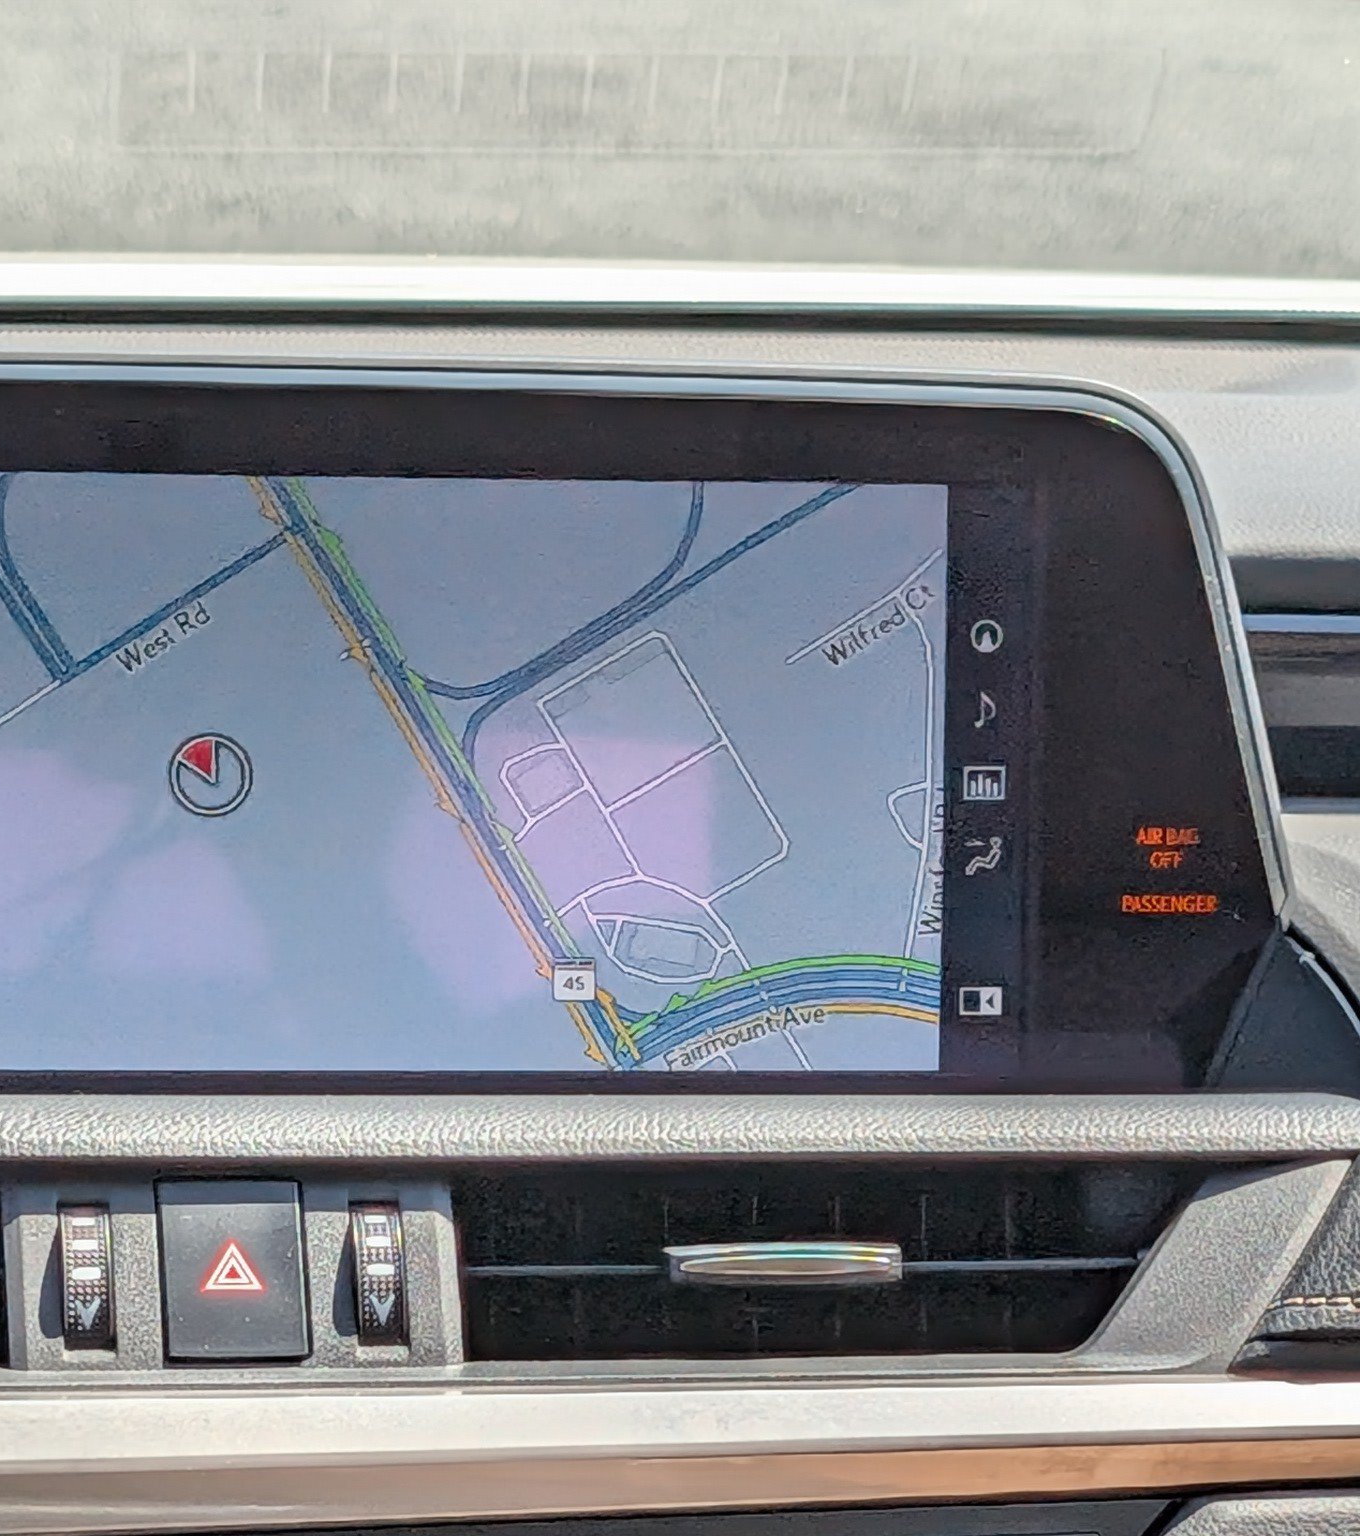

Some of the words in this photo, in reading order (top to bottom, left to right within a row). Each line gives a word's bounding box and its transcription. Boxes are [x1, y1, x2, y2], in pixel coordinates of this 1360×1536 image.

[116, 629, 176, 672] West
[175, 601, 211, 635] Rd
[822, 604, 905, 666] Wilfred
[905, 585, 935, 611] Ct
[1136, 827, 1163, 845] AIR
[1149, 851, 1184, 869] OFF
[1121, 895, 1218, 912] PASSENGER
[663, 1015, 775, 1071] Fairmount
[781, 1006, 825, 1030] Ave
